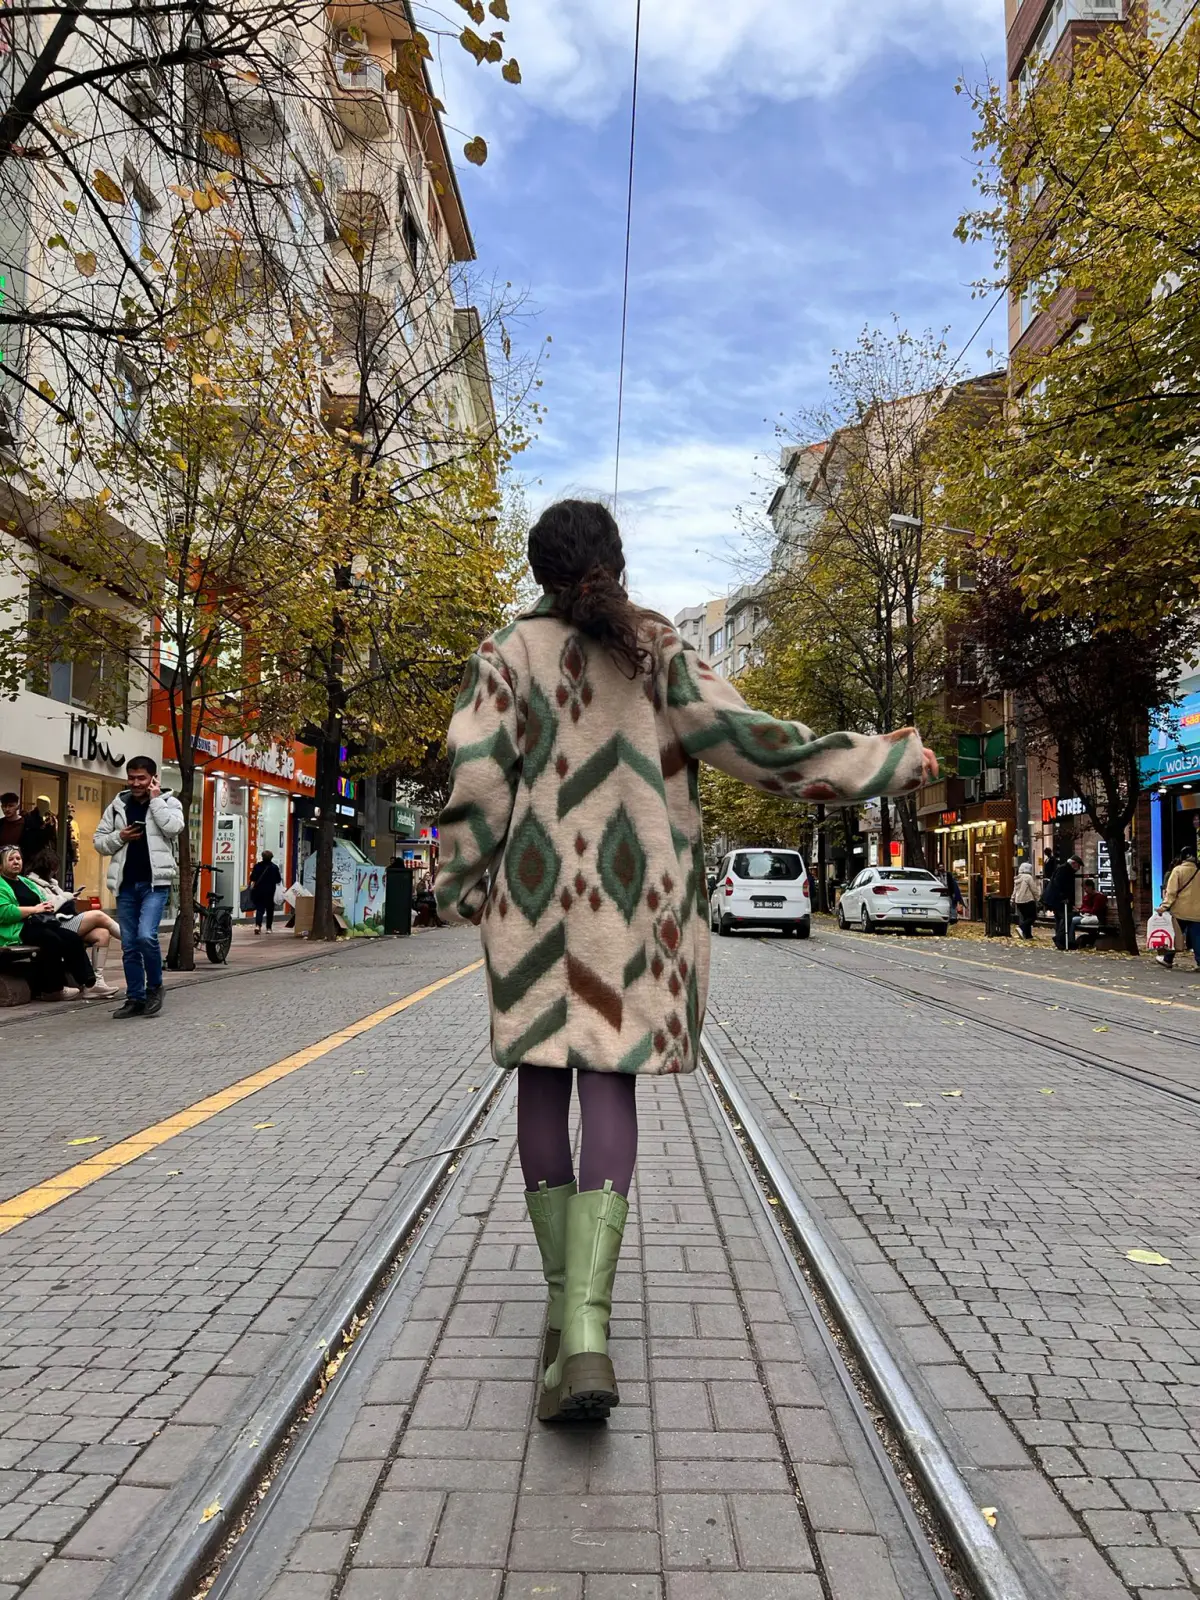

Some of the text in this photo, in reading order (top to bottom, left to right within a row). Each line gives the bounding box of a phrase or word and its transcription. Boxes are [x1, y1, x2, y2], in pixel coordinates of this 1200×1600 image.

[69, 712, 98, 761] LTB
[1165, 755, 1200, 773] watso
[77, 785, 99, 802] LTB
[1042, 797, 1057, 822] IN
